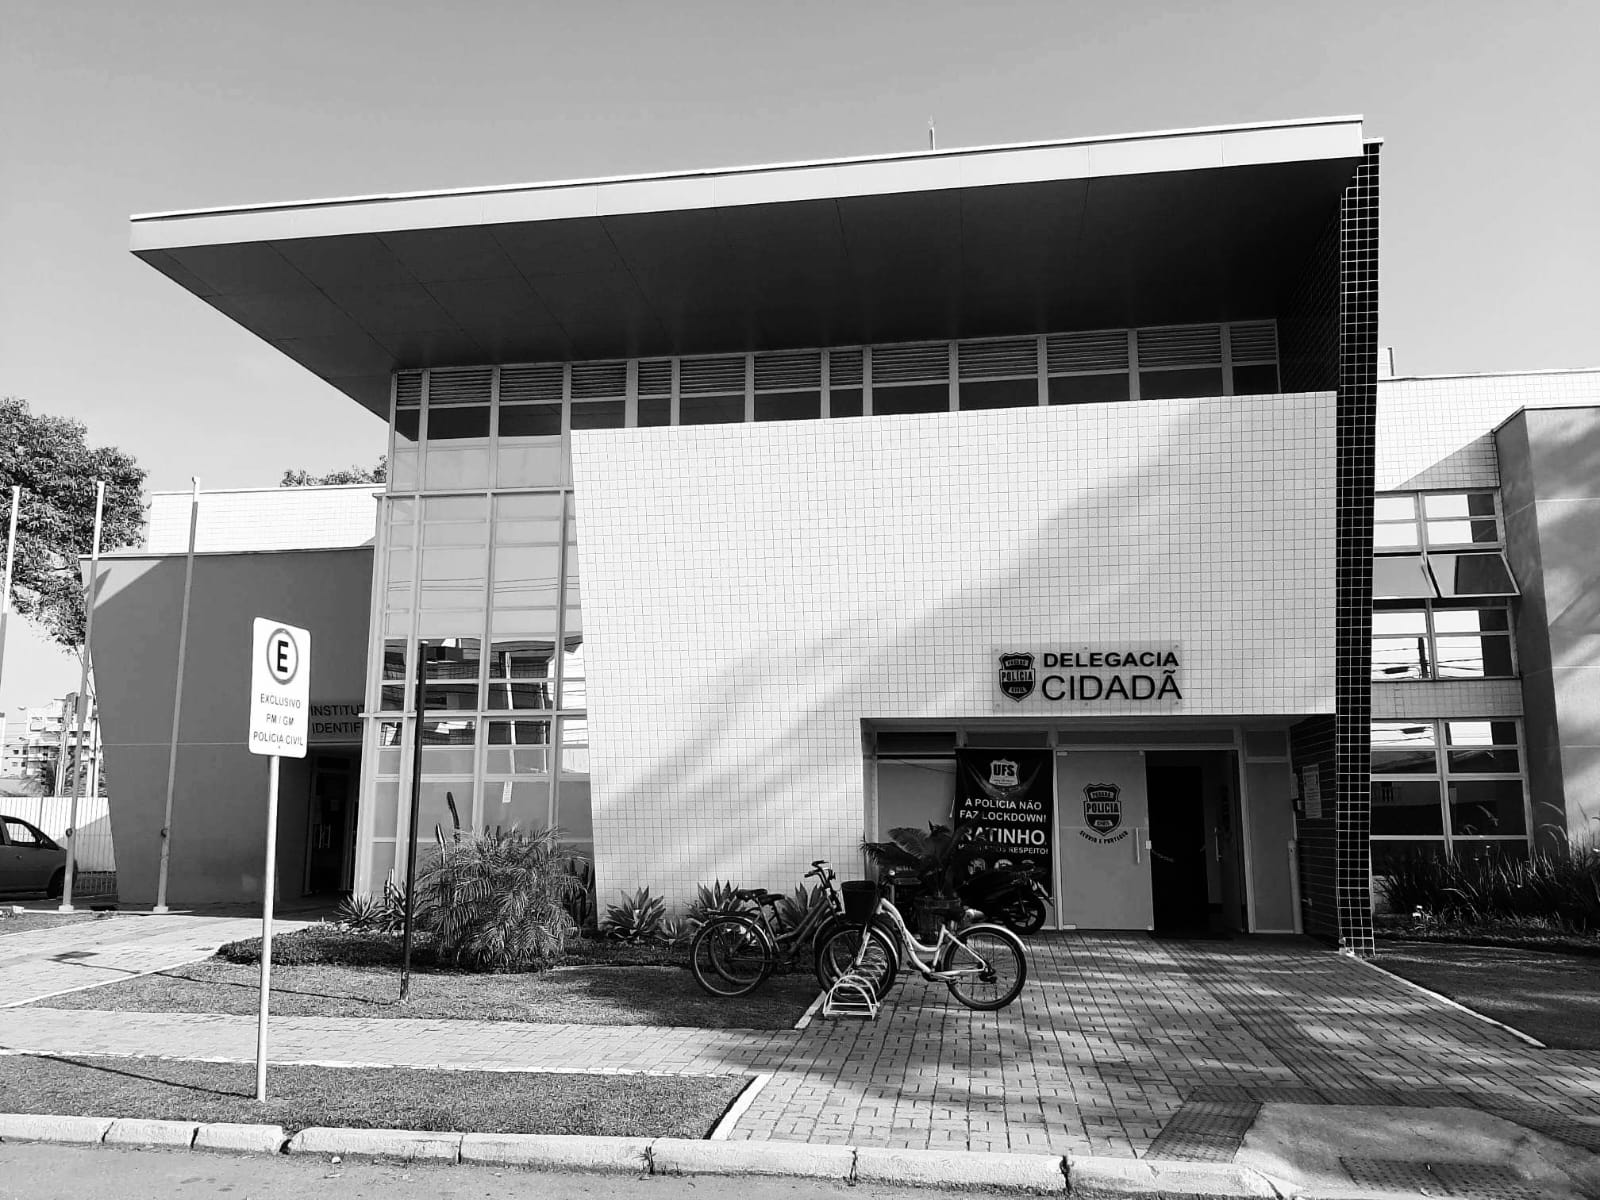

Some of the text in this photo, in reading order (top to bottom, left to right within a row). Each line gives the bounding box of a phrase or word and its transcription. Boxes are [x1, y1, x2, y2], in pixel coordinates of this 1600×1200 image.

[277, 640, 289, 673] E
[1043, 652, 1179, 667] DELEGACIA
[1041, 669, 1183, 700] CIDADÃ
[260, 693, 301, 709] EXCLUSIVO
[285, 735, 304, 746] CIVIL
[993, 764, 1015, 777] UFS
[964, 797, 973, 807] A
[1019, 800, 1042, 811] NÃO
[981, 811, 1047, 823] LOCKDOWN!
